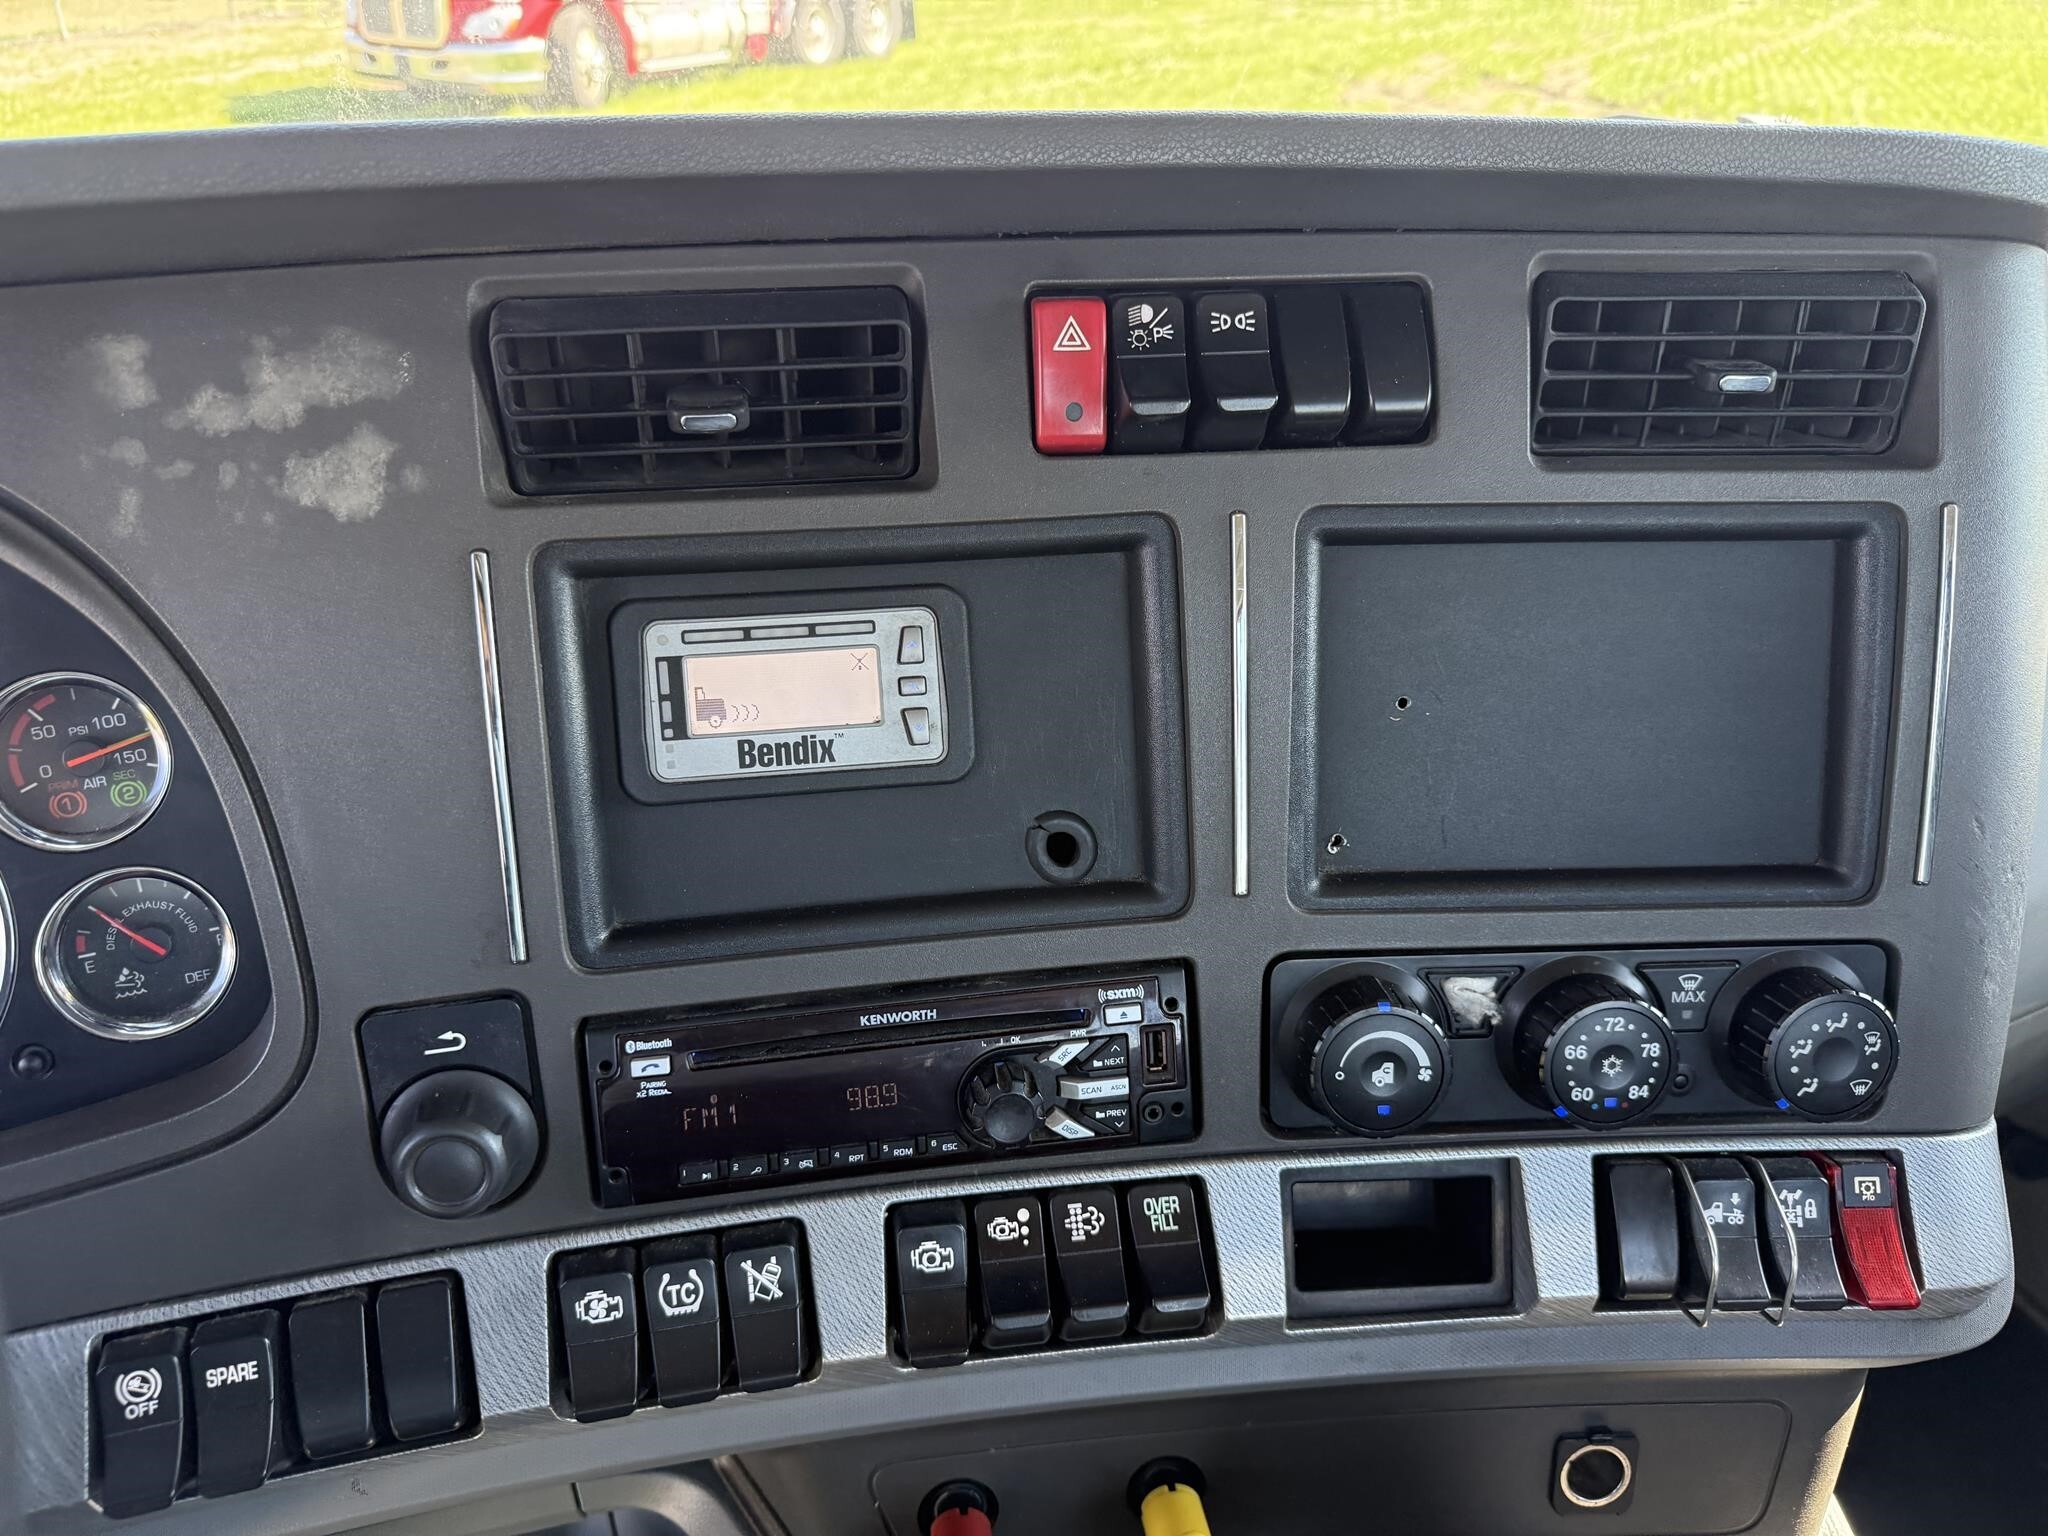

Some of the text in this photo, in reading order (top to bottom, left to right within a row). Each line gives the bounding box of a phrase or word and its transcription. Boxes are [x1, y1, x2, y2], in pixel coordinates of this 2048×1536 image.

[92, 713, 127, 730] 100
[30, 724, 56, 740] 50
[68, 725, 89, 736] PSI
[113, 748, 147, 765] 150
[737, 735, 836, 769] Bendix
[39, 764, 52, 778] 0
[112, 769, 136, 781] SEC
[83, 776, 107, 790] AIR
[106, 901, 198, 951] DIESL EXHAUST FLUID
[84, 960, 96, 974] E
[184, 969, 211, 984] DEF
[1107, 988, 1136, 1000] sxm
[1671, 991, 1705, 1003] MAX
[860, 1009, 937, 1026] KENWORTH
[1604, 1017, 1626, 1032] 72
[1010, 1036, 1021, 1044] OK
[1070, 1029, 1087, 1038] PWR
[636, 1038, 673, 1051] Bluetooth
[1641, 1043, 1660, 1057] 78
[1058, 1048, 1072, 1062] SRC
[1564, 1045, 1588, 1060] 66
[1104, 1056, 1125, 1067] NEXT
[1081, 1086, 1102, 1095] SCAN
[1571, 1087, 1594, 1101] 60
[1628, 1084, 1649, 1099] 84
[1106, 1108, 1127, 1117] PREV
[1061, 1124, 1079, 1137] DISP
[883, 1144, 913, 1157] 5 RDM
[931, 1139, 958, 1151] 6 ESC
[783, 1158, 790, 1166] 3
[848, 1154, 865, 1163] RPT
[733, 1163, 739, 1171] 2
[1143, 1195, 1180, 1215] OVER
[1150, 1213, 1179, 1232] FILL
[666, 1282, 696, 1306] TC
[205, 1360, 259, 1388] SPARE
[124, 1400, 159, 1420] OFF
